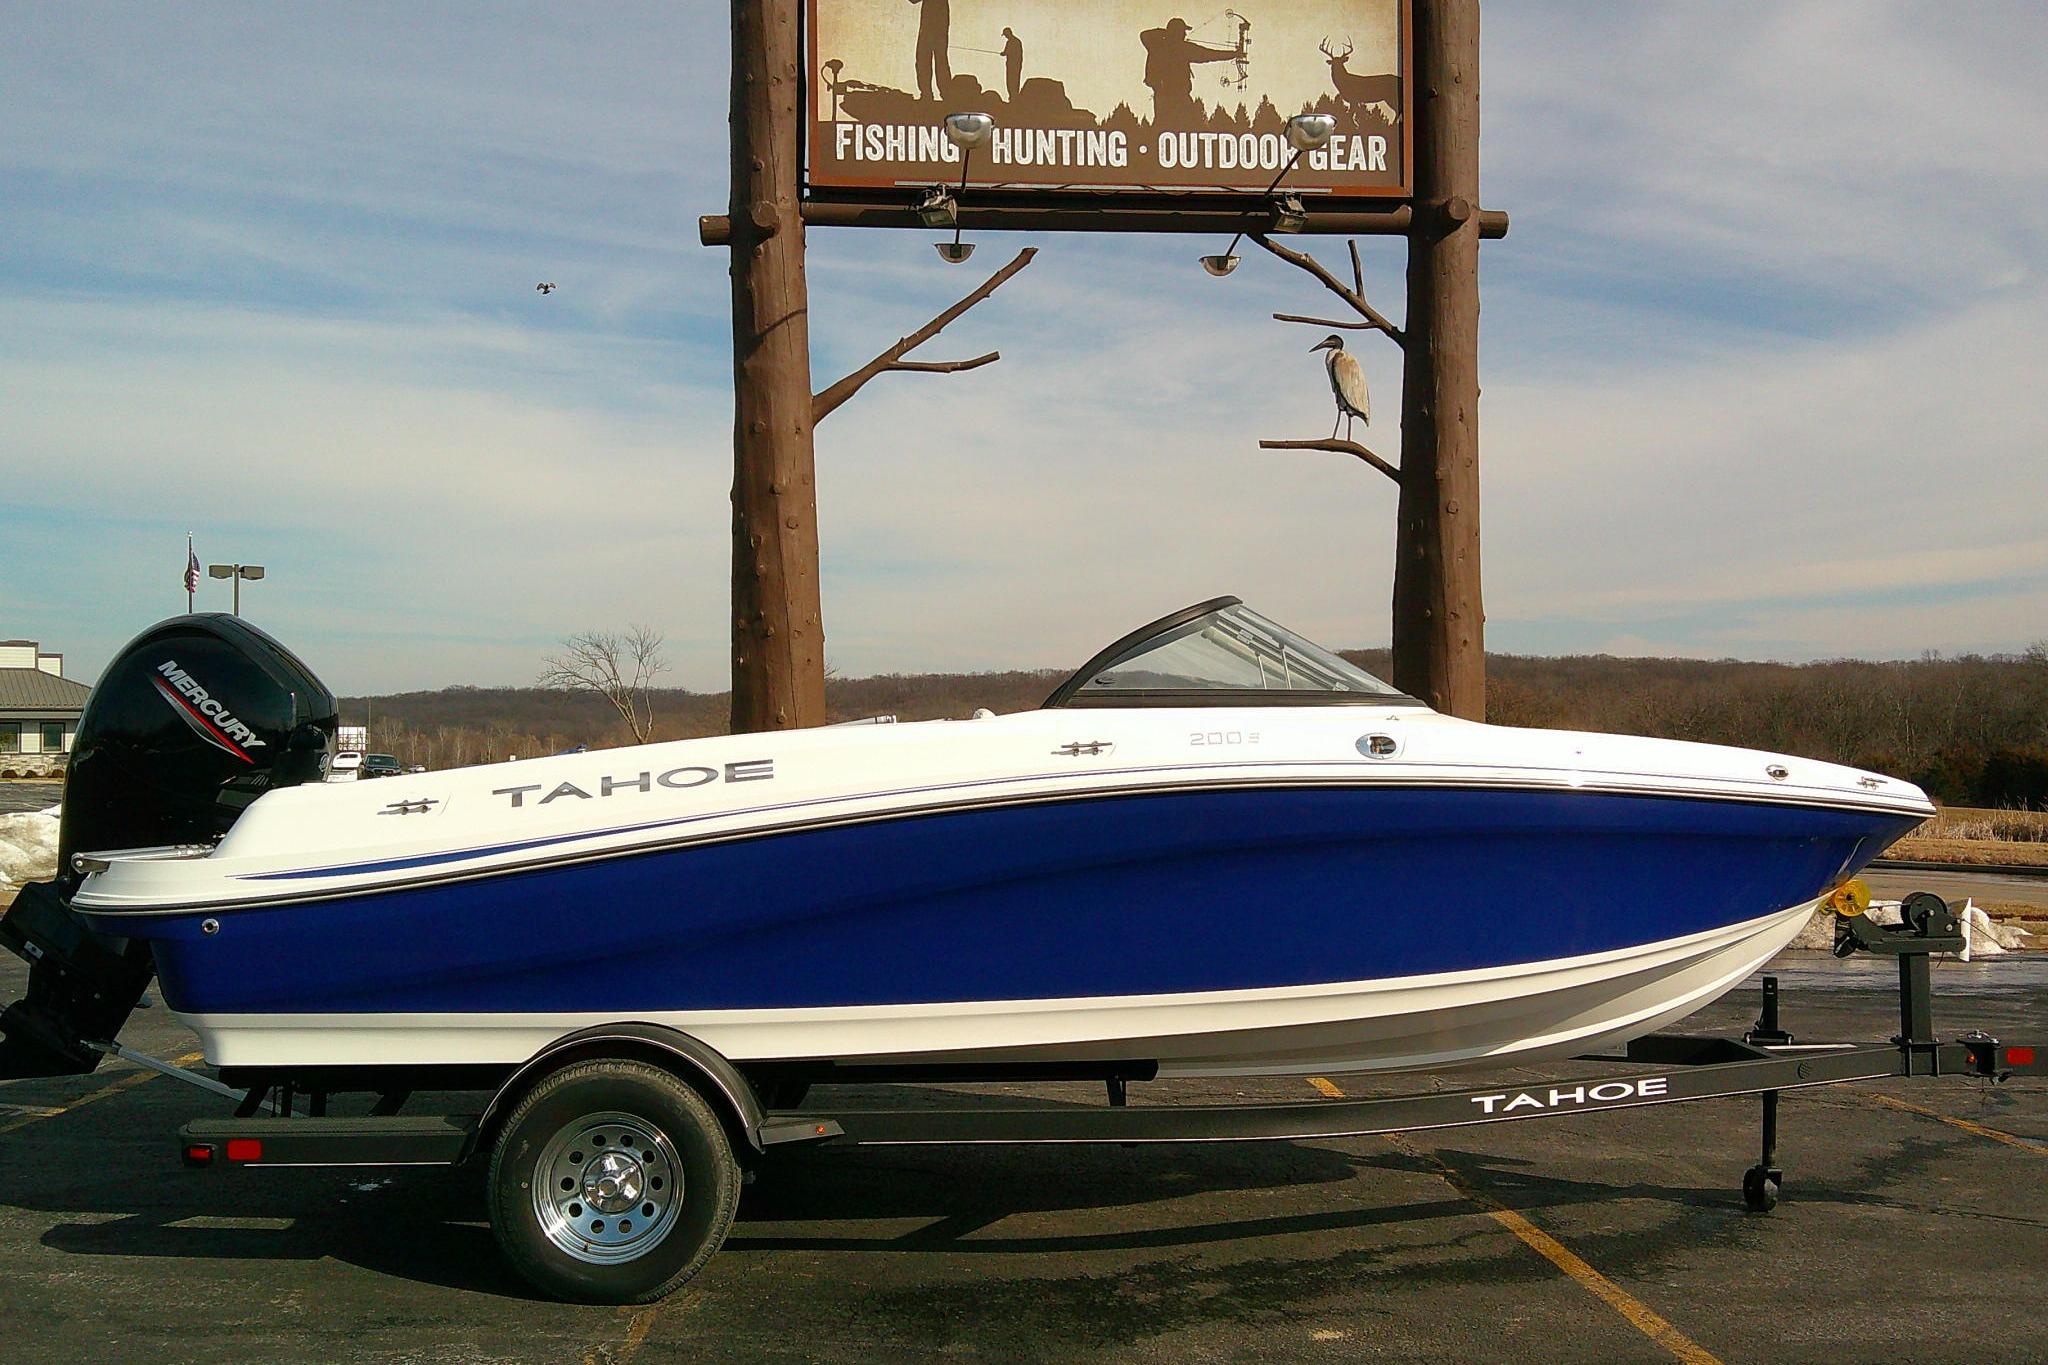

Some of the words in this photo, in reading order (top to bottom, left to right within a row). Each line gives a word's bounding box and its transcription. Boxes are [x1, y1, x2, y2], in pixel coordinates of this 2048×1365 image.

[835, 123, 960, 163] FISHING
[992, 128, 1128, 167] HUNTING
[1308, 135, 1388, 171] GEAR
[157, 659, 267, 748] MERCURY
[492, 759, 774, 807] TAHOE
[1471, 1077, 1668, 1113] TAHOE
